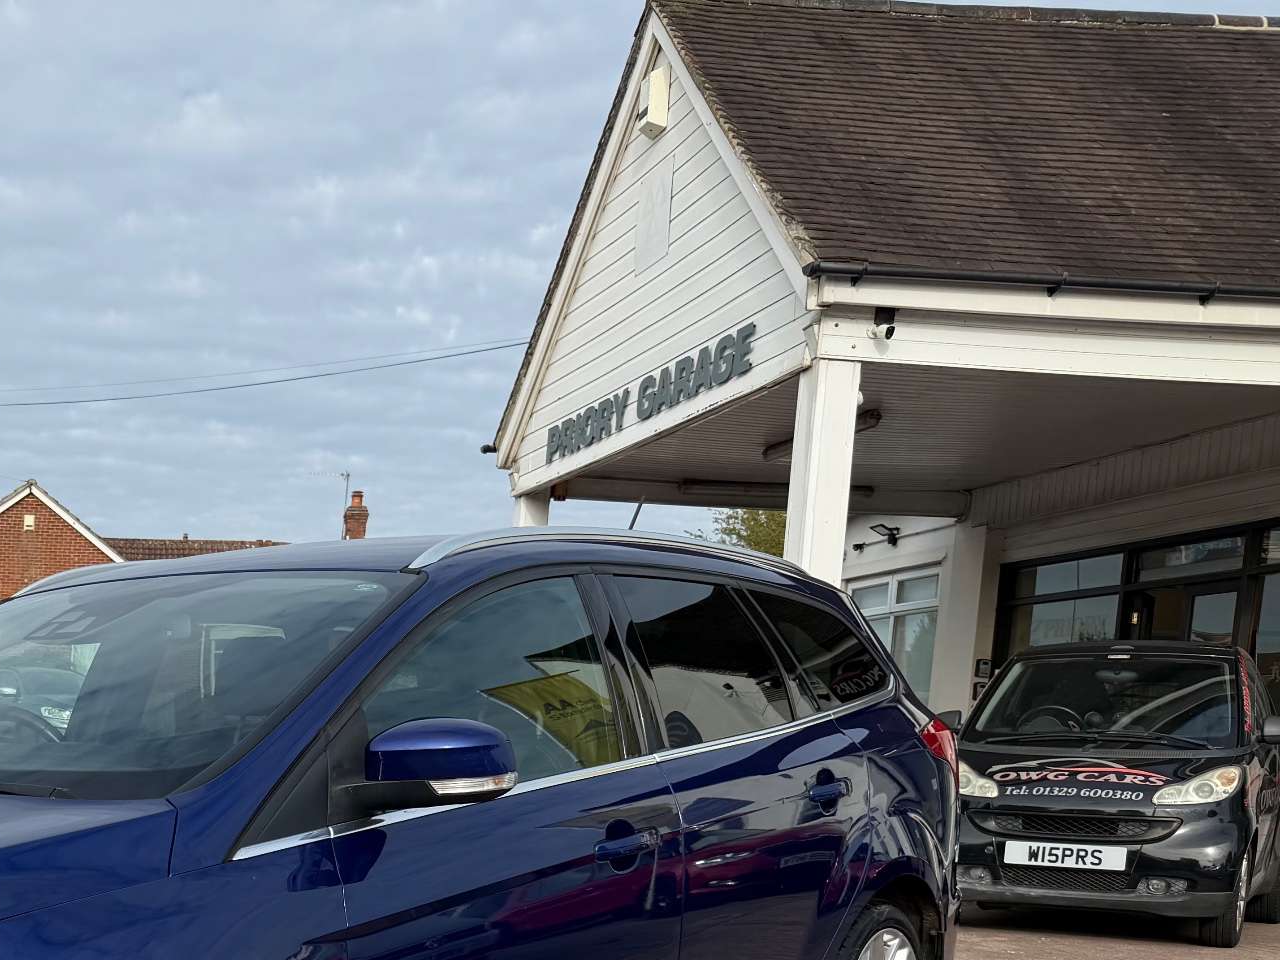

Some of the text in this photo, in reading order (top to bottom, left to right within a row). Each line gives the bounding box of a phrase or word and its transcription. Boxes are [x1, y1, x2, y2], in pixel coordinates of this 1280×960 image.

[546, 321, 757, 464] PRIORY GARAGE
[993, 771, 1169, 786] OWG CARS
[1005, 786, 1144, 801] Tel: 01329 600380
